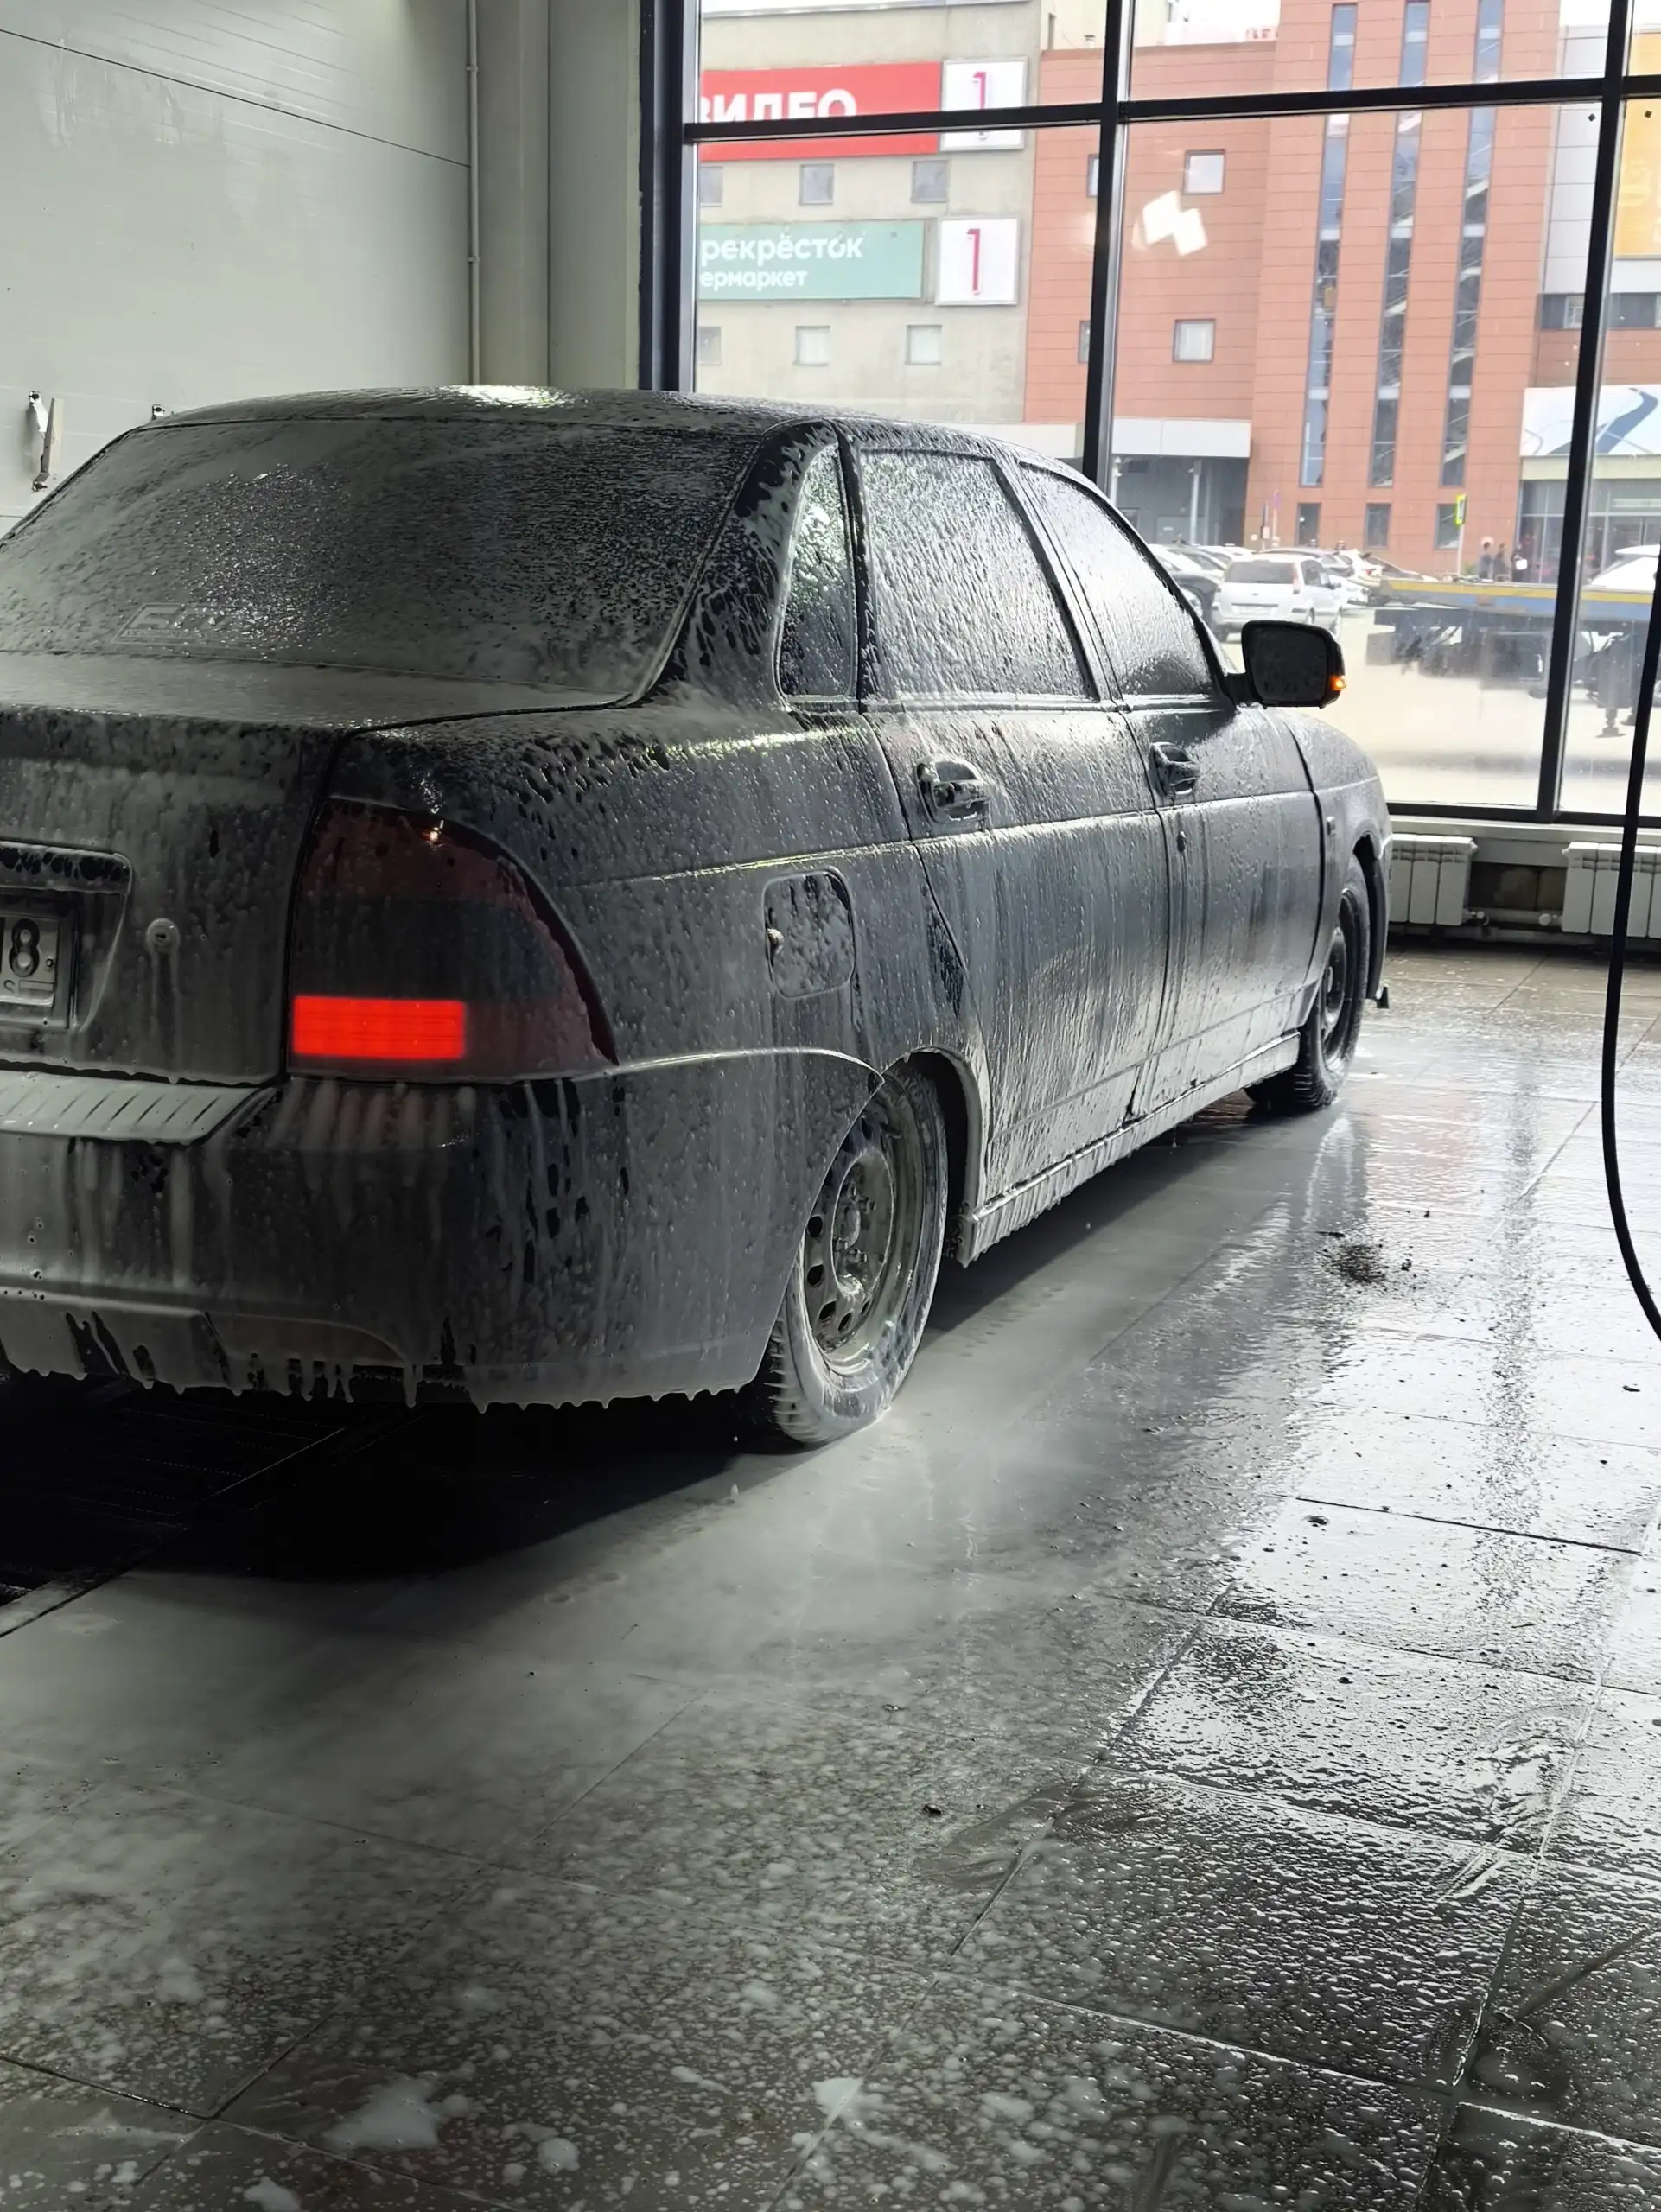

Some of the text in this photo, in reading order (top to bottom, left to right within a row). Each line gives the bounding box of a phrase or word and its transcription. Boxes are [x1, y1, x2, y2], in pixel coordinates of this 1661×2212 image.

[700, 270, 808, 293] ермаркет
[966, 228, 981, 292] 1
[0, 917, 41, 978] 8
